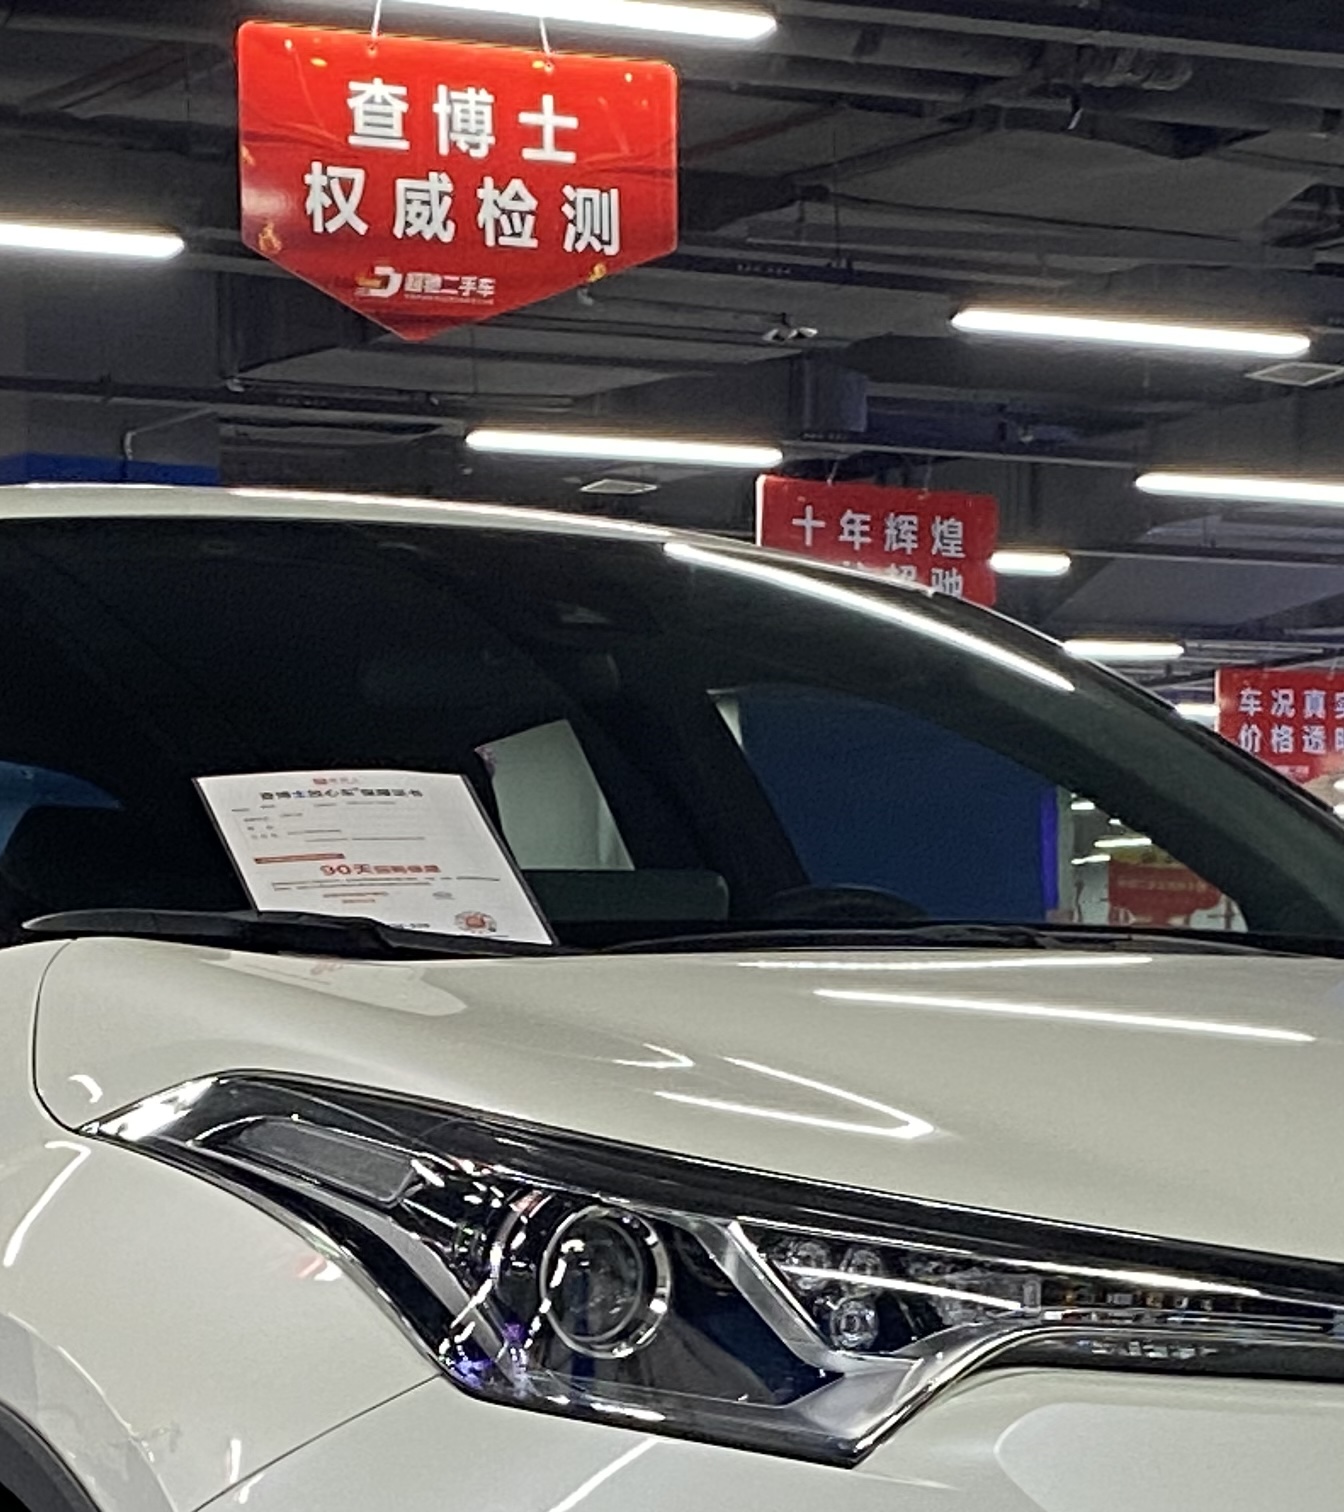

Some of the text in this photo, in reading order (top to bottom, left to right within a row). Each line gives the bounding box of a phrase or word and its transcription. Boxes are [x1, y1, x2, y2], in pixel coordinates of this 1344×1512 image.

[346, 77, 579, 164] 查博士
[303, 161, 621, 256] 权威检测
[791, 504, 966, 559] 十年辉煌
